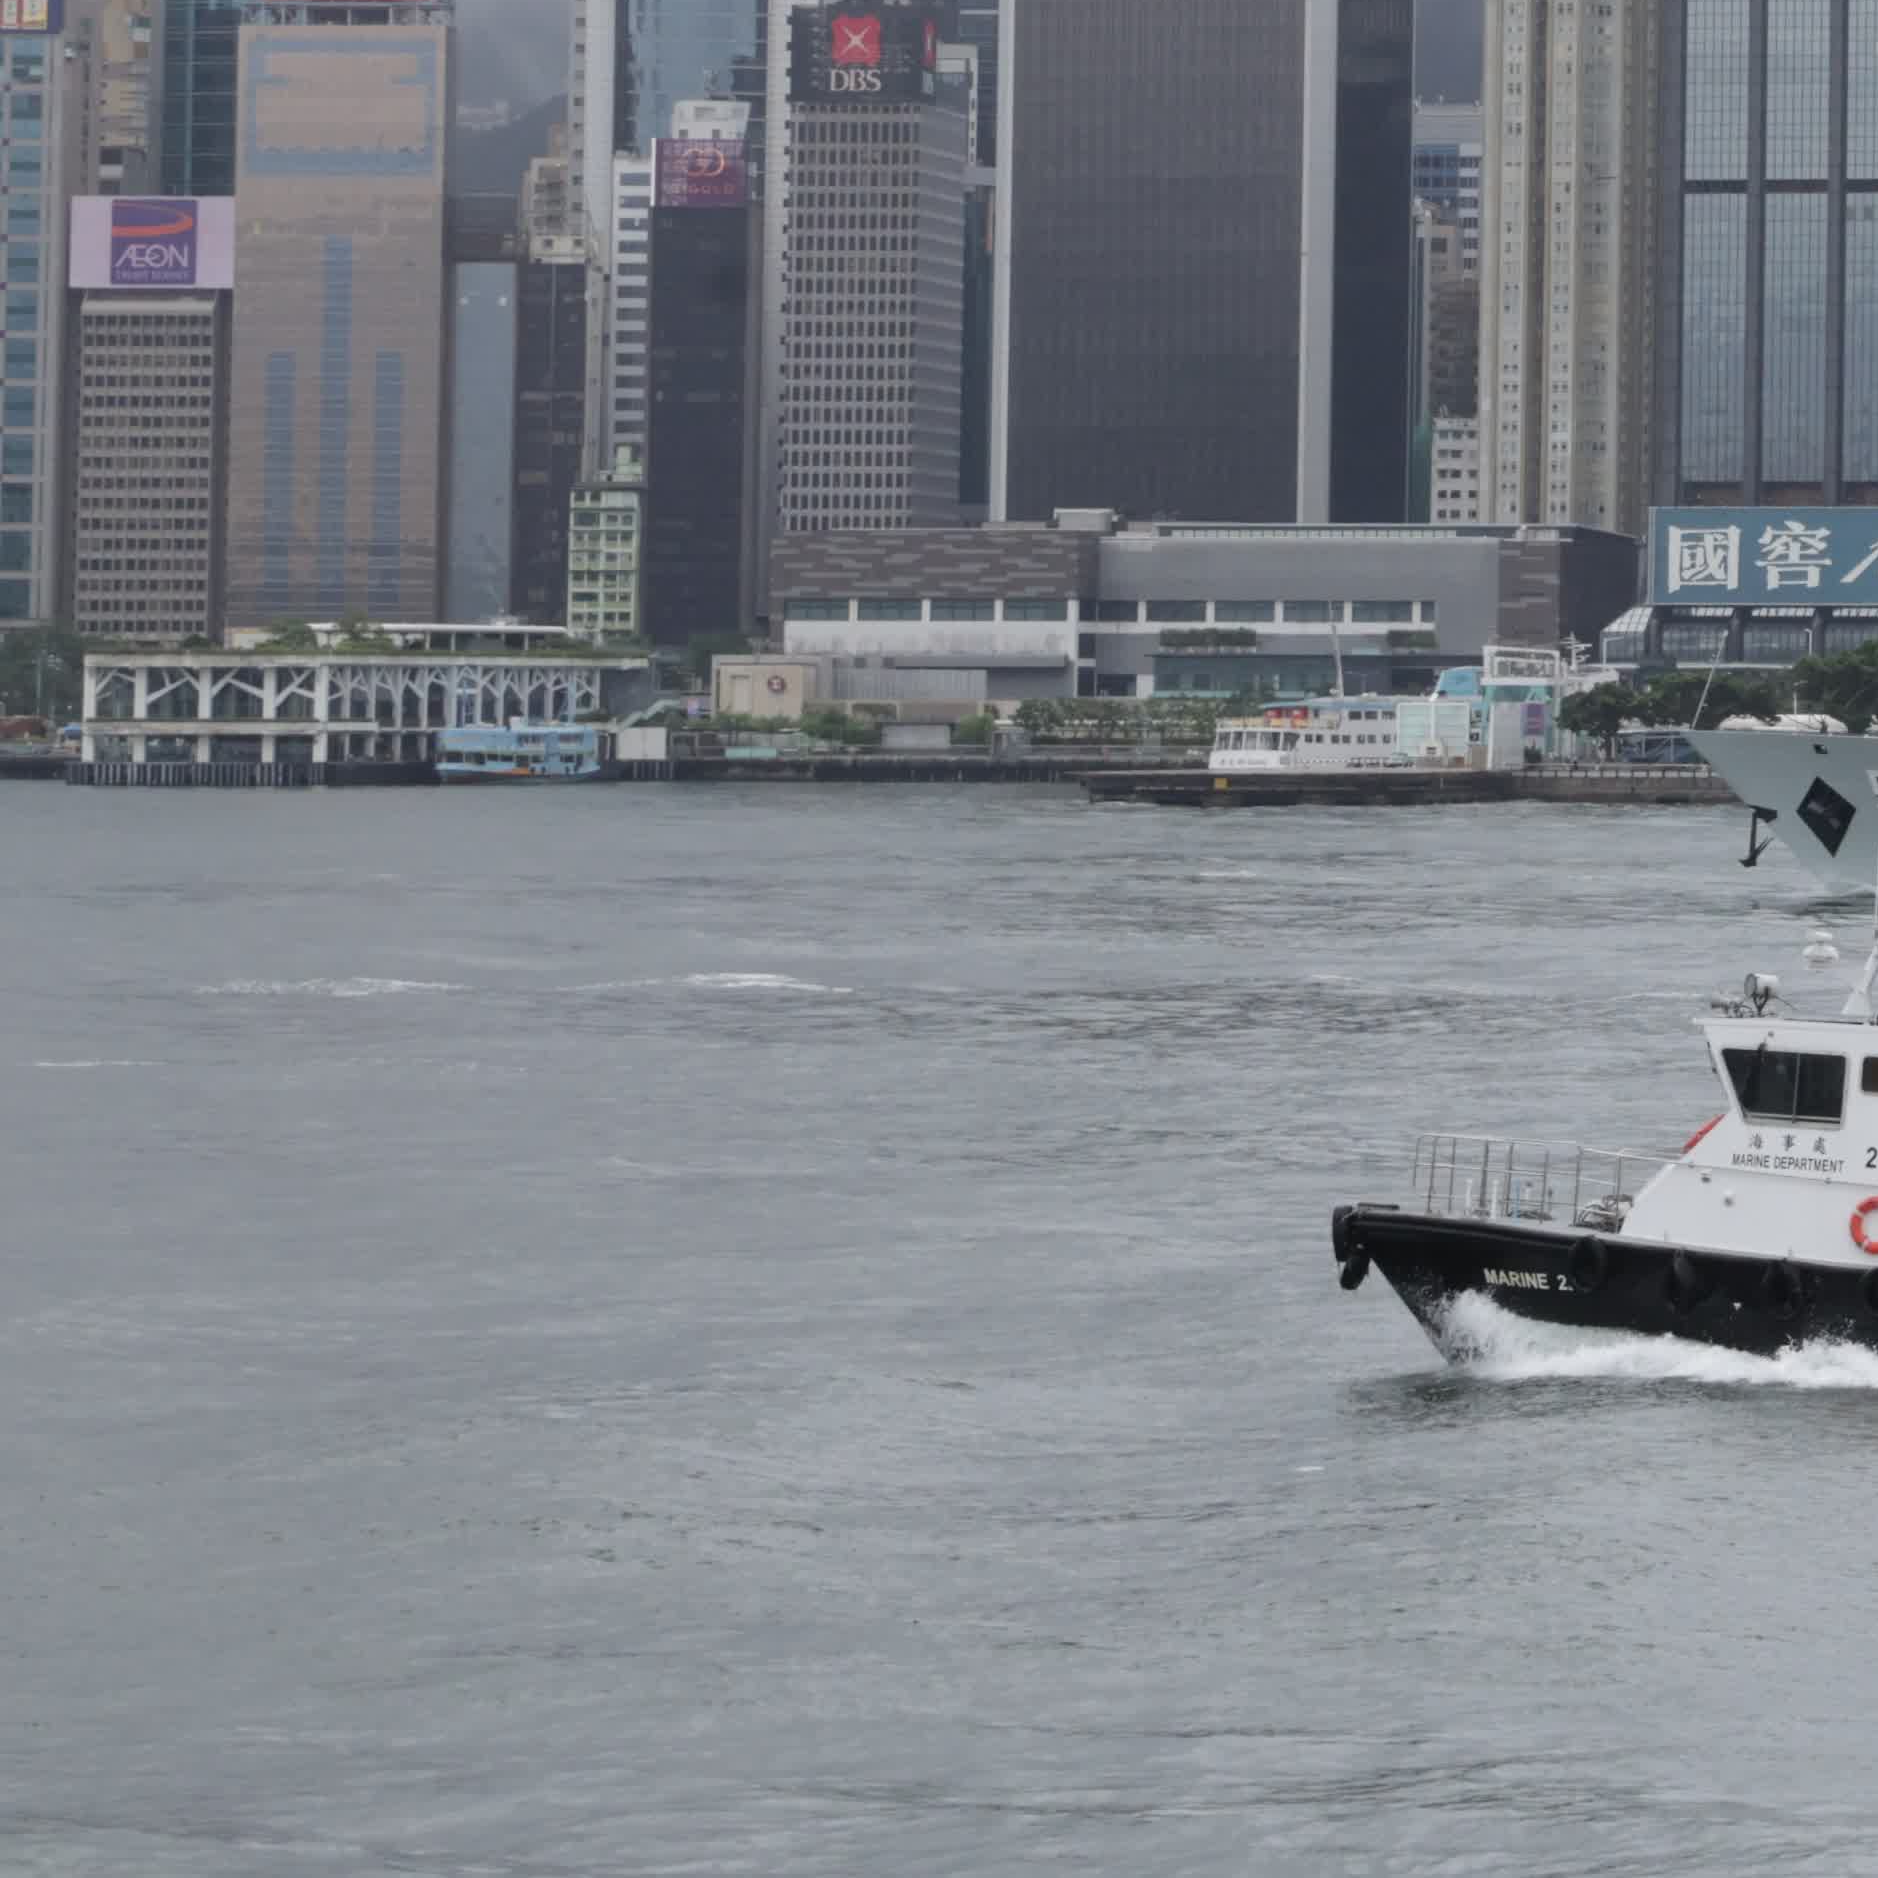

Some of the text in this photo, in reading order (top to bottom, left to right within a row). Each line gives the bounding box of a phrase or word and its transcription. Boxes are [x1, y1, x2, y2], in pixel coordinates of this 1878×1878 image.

[829, 67, 882, 92] DBS
[1731, 1153, 1845, 1173] MARINE DEPARTMENT
[1483, 1266, 1551, 1291] MARINE
